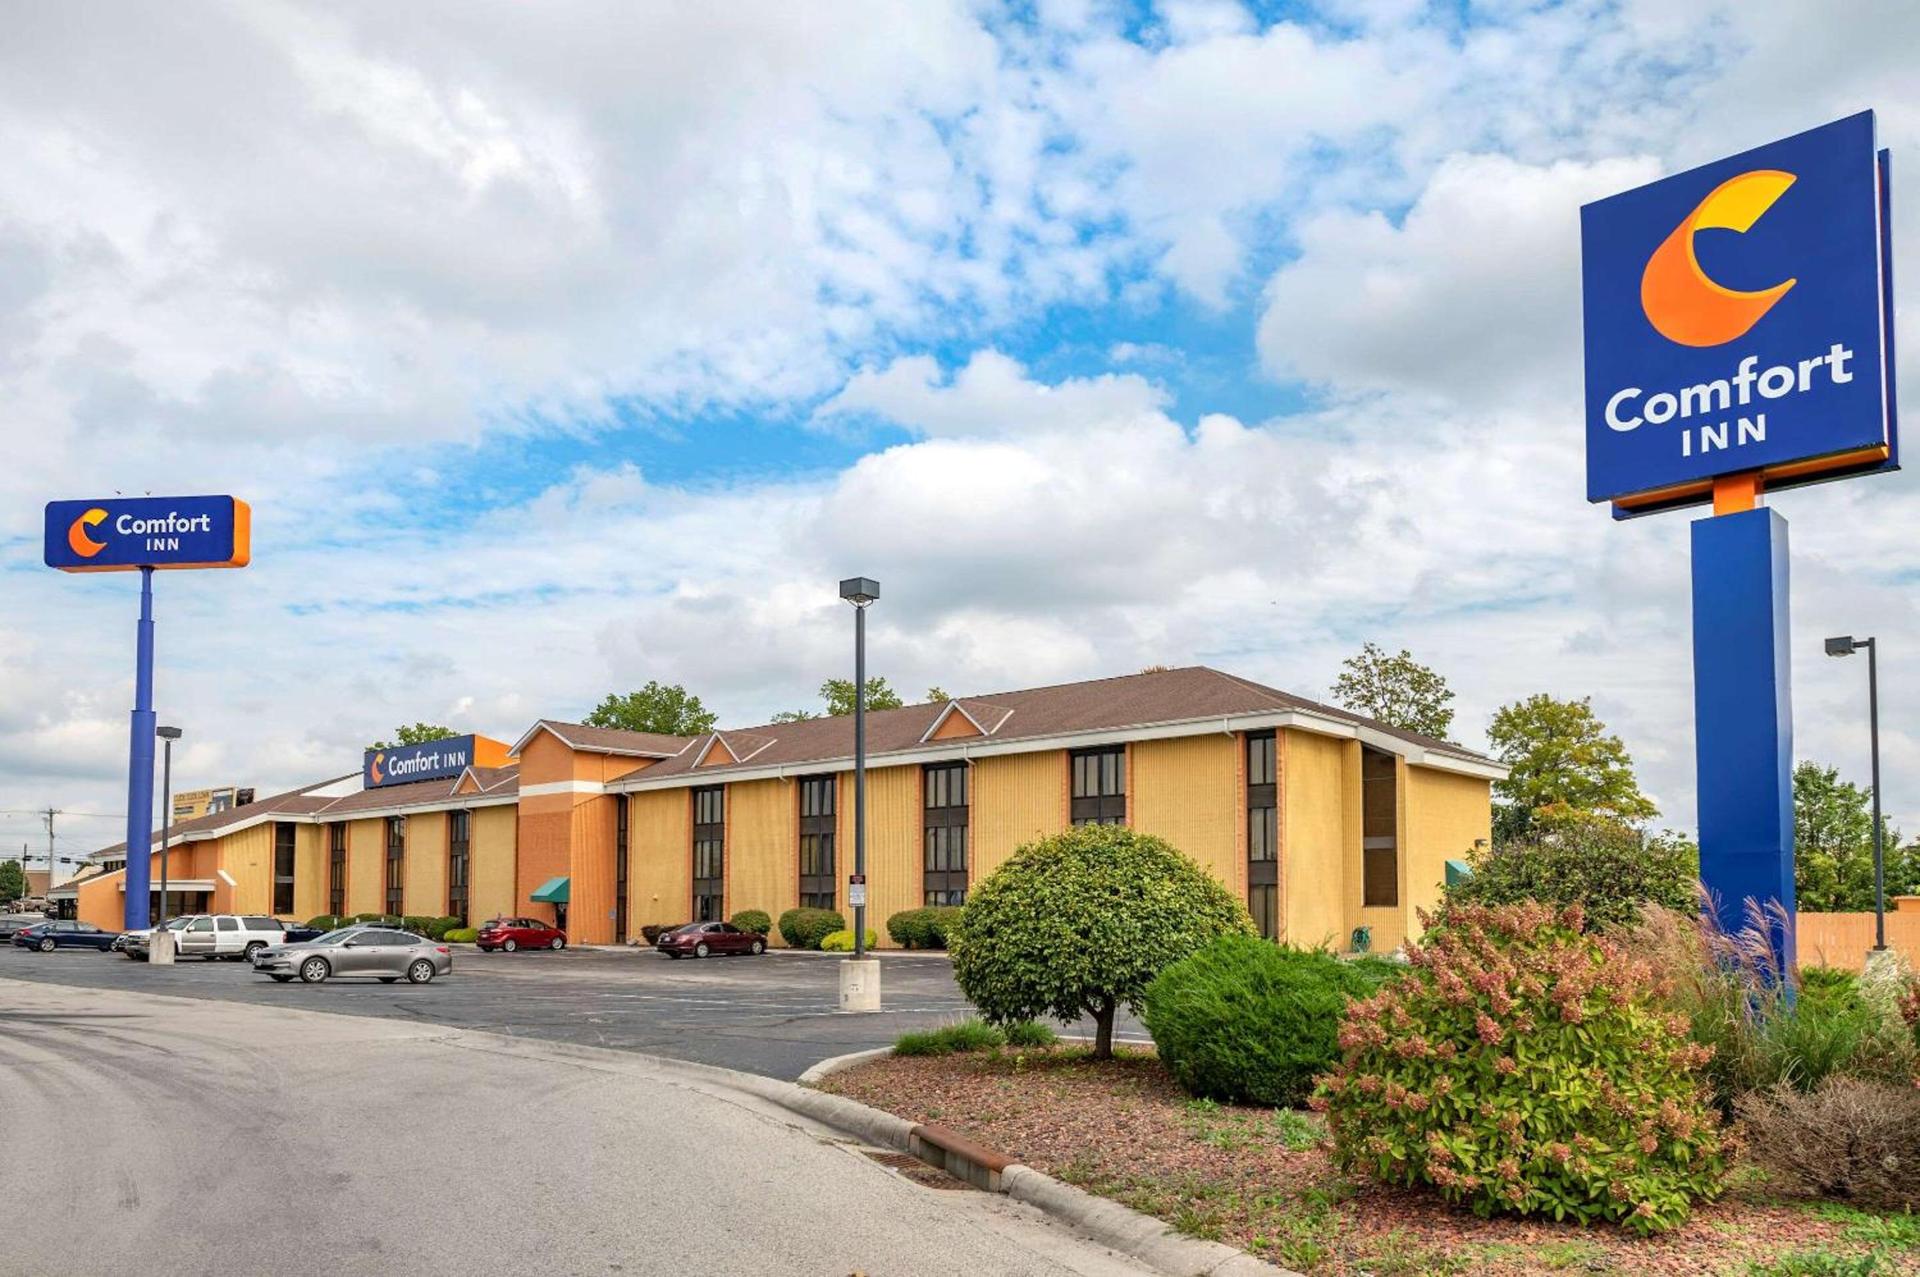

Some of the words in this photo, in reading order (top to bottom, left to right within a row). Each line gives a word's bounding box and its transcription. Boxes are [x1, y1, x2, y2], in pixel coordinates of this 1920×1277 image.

[1604, 343, 1853, 432] Comfort
[1682, 414, 1766, 457] INN
[116, 512, 211, 534] Comfort
[147, 538, 179, 551] INN
[389, 751, 439, 776] Comfort
[443, 752, 465, 767] INN
